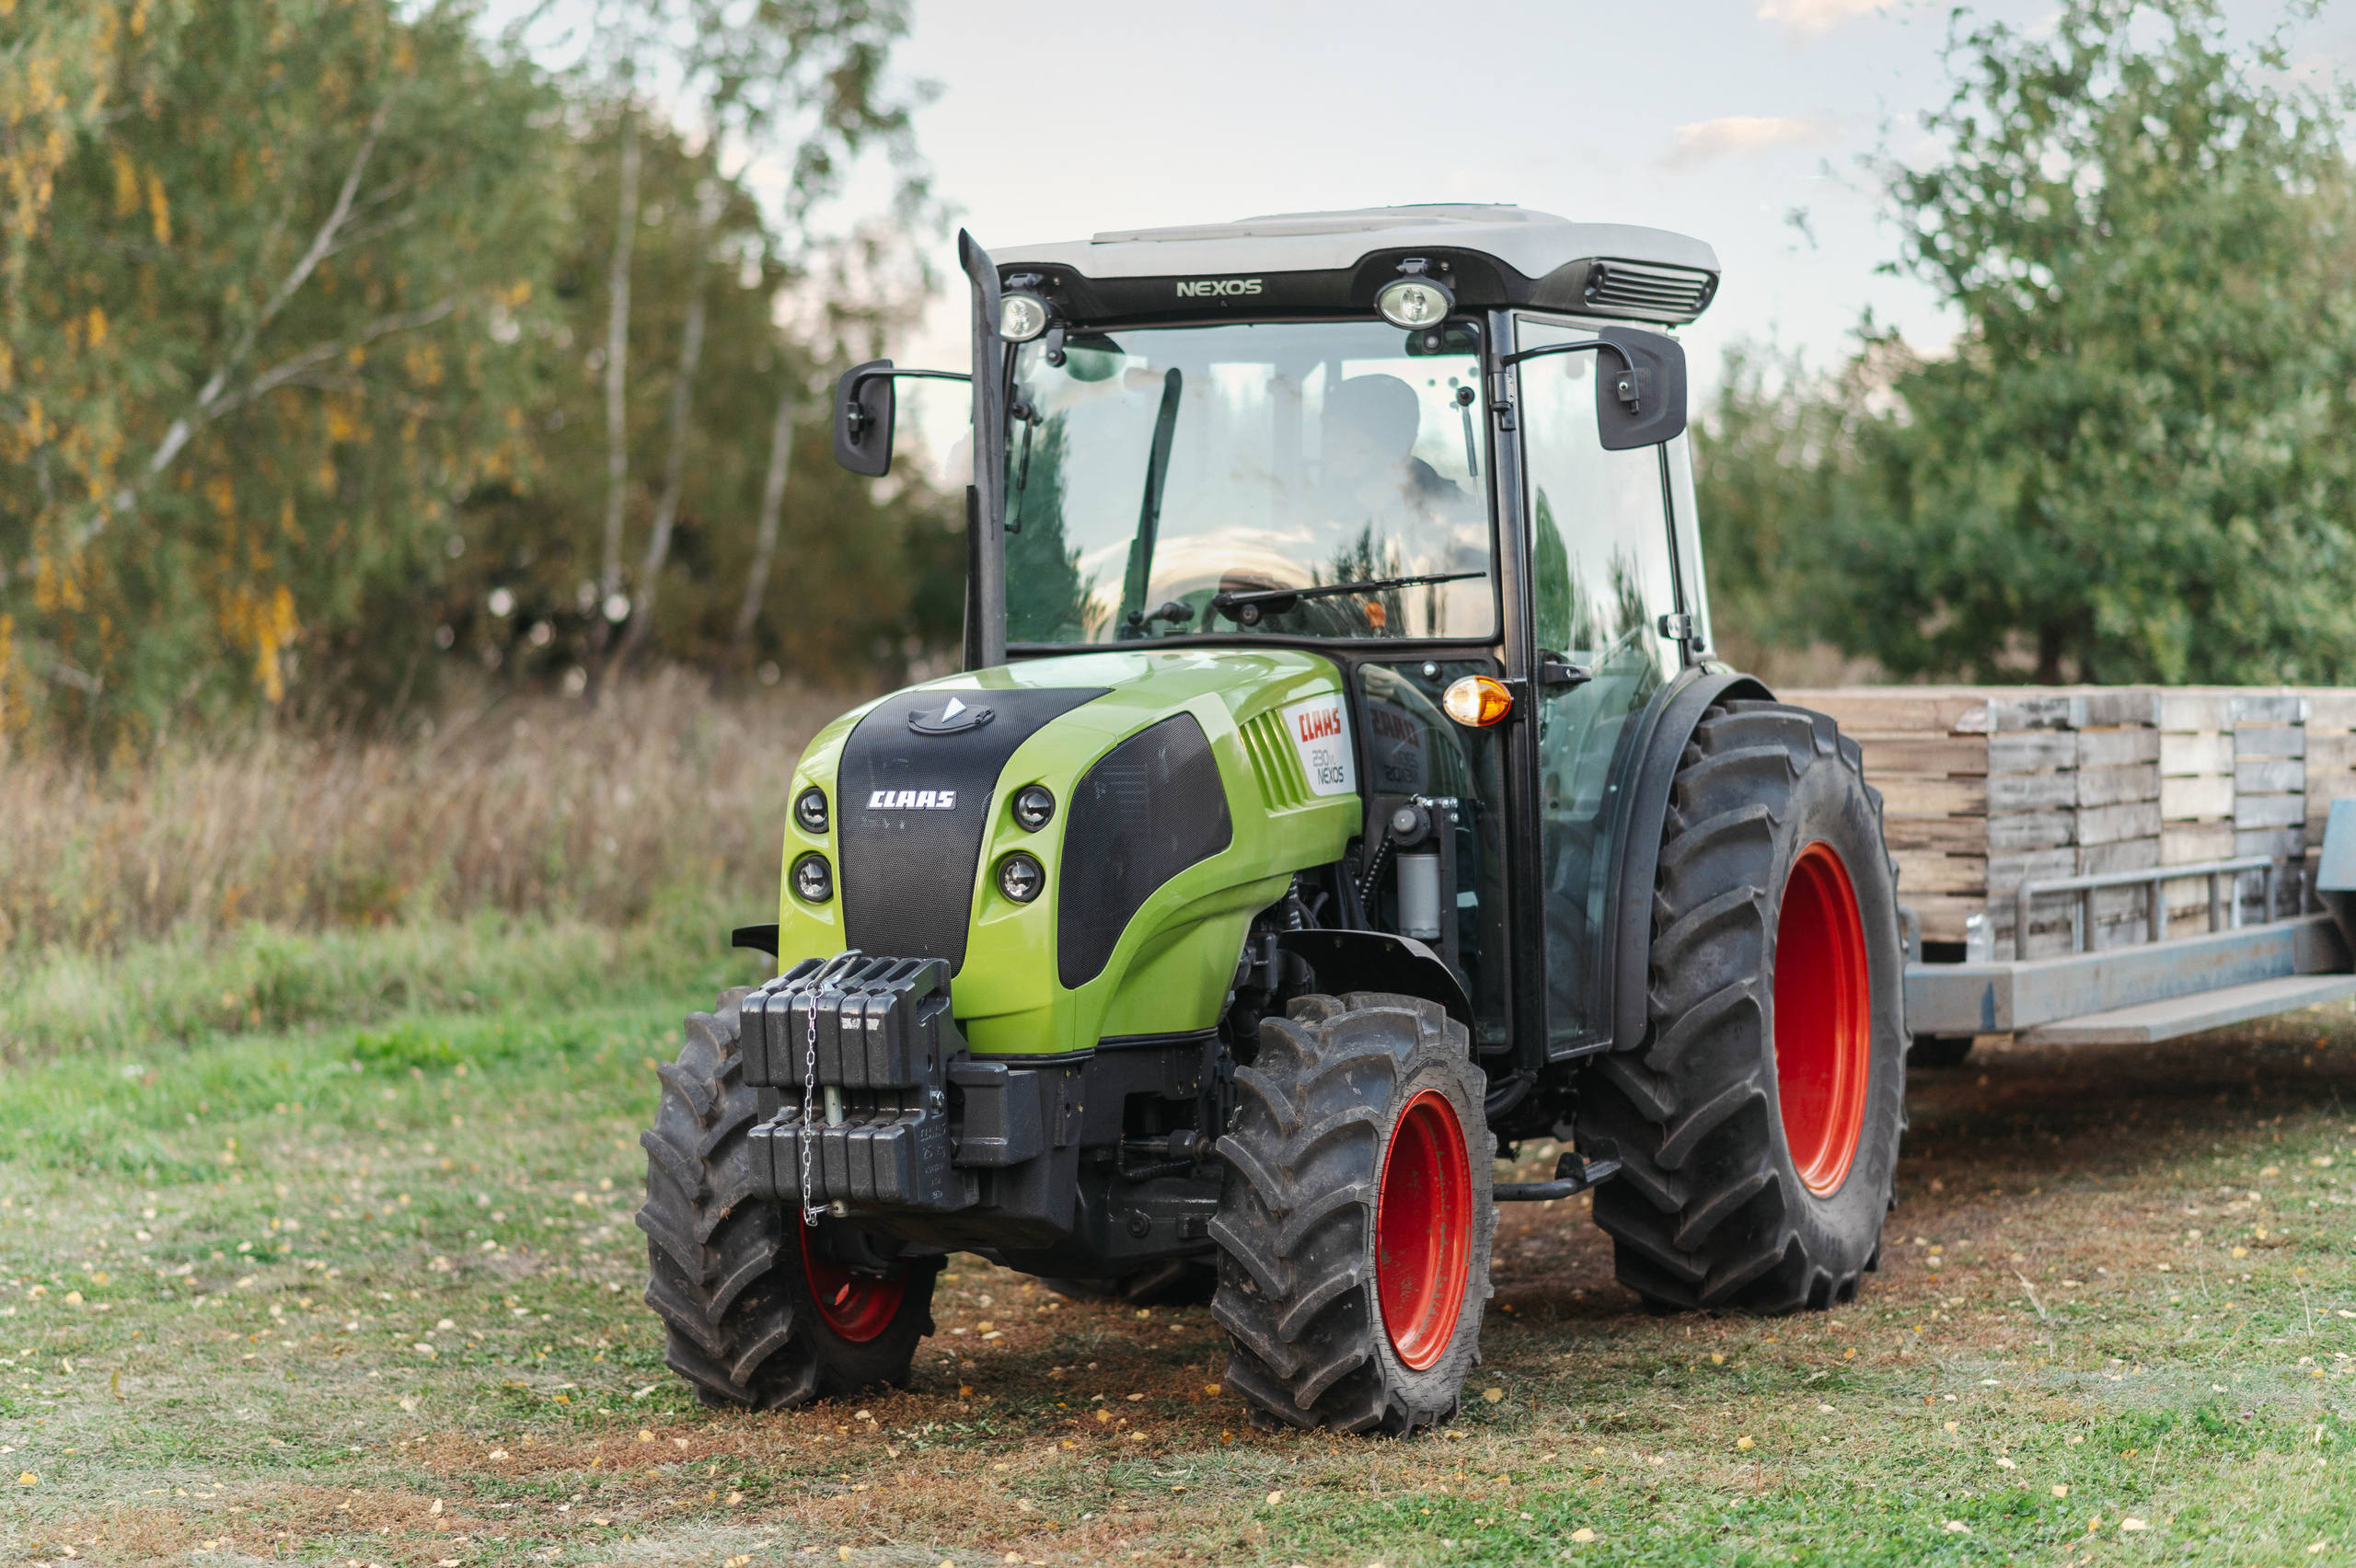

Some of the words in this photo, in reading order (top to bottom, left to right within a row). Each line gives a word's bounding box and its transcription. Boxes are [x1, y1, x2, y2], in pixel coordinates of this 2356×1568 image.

[1177, 279, 1263, 297] NEXOS
[1299, 707, 1341, 743] CLAAS
[1317, 766, 1345, 785] NEXOS
[869, 790, 955, 808] CLAAS
